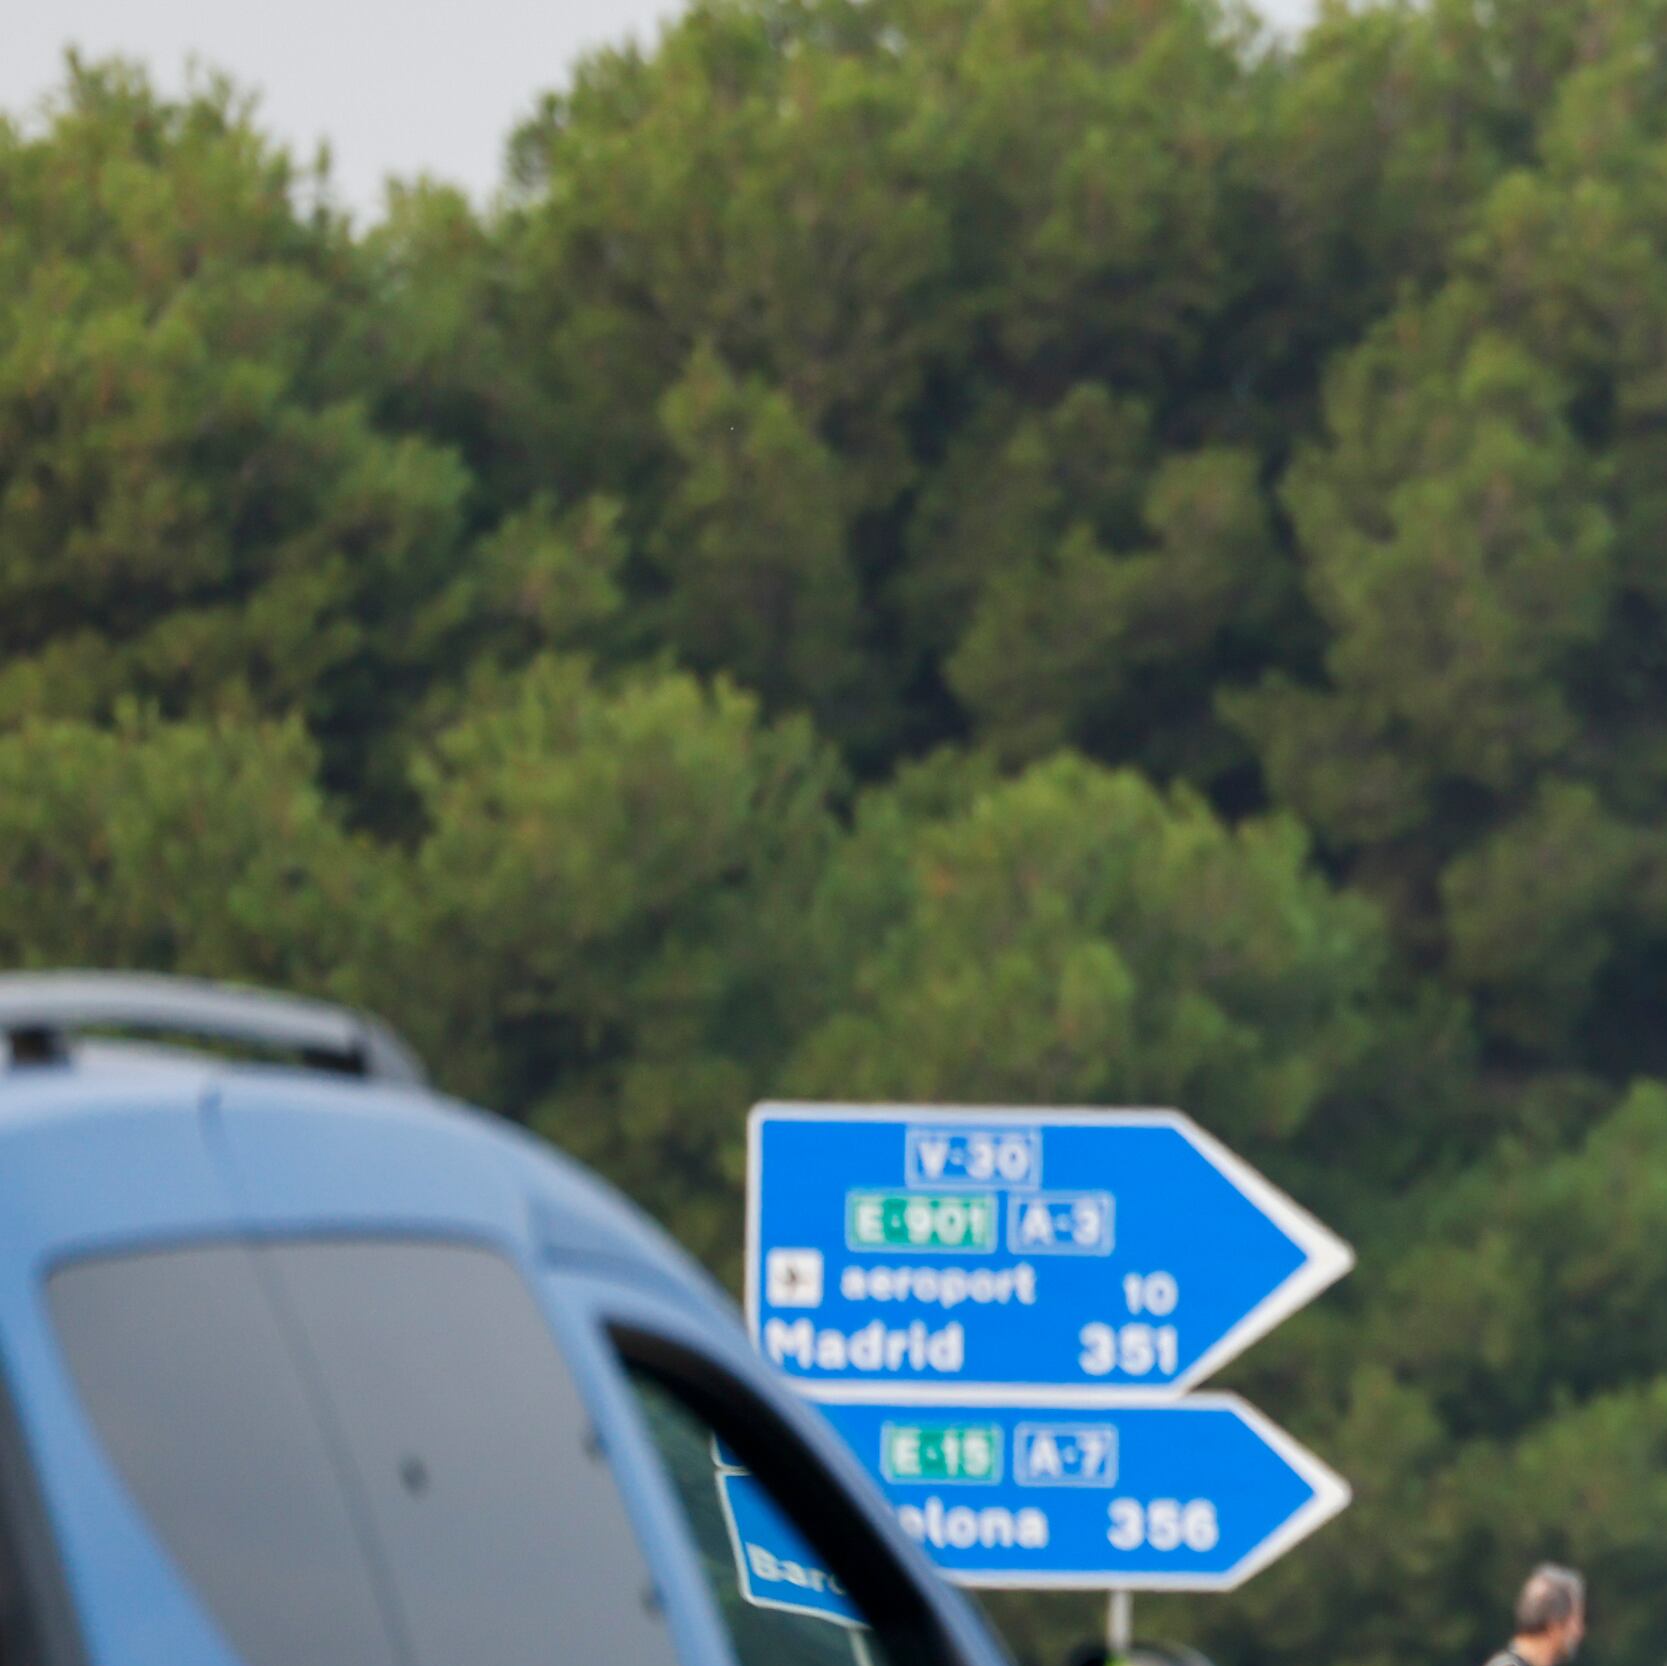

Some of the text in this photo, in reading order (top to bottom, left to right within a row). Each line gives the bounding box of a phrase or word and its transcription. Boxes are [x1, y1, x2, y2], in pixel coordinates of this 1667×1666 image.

[916, 1136, 1030, 1181] V-30
[1021, 1199, 1101, 1247] A-3
[840, 1261, 1179, 1317] aeroport 10
[764, 1317, 1178, 1376] Madrid 351
[1029, 1429, 1108, 1478] A-7
[1107, 1497, 1219, 1552] 356
